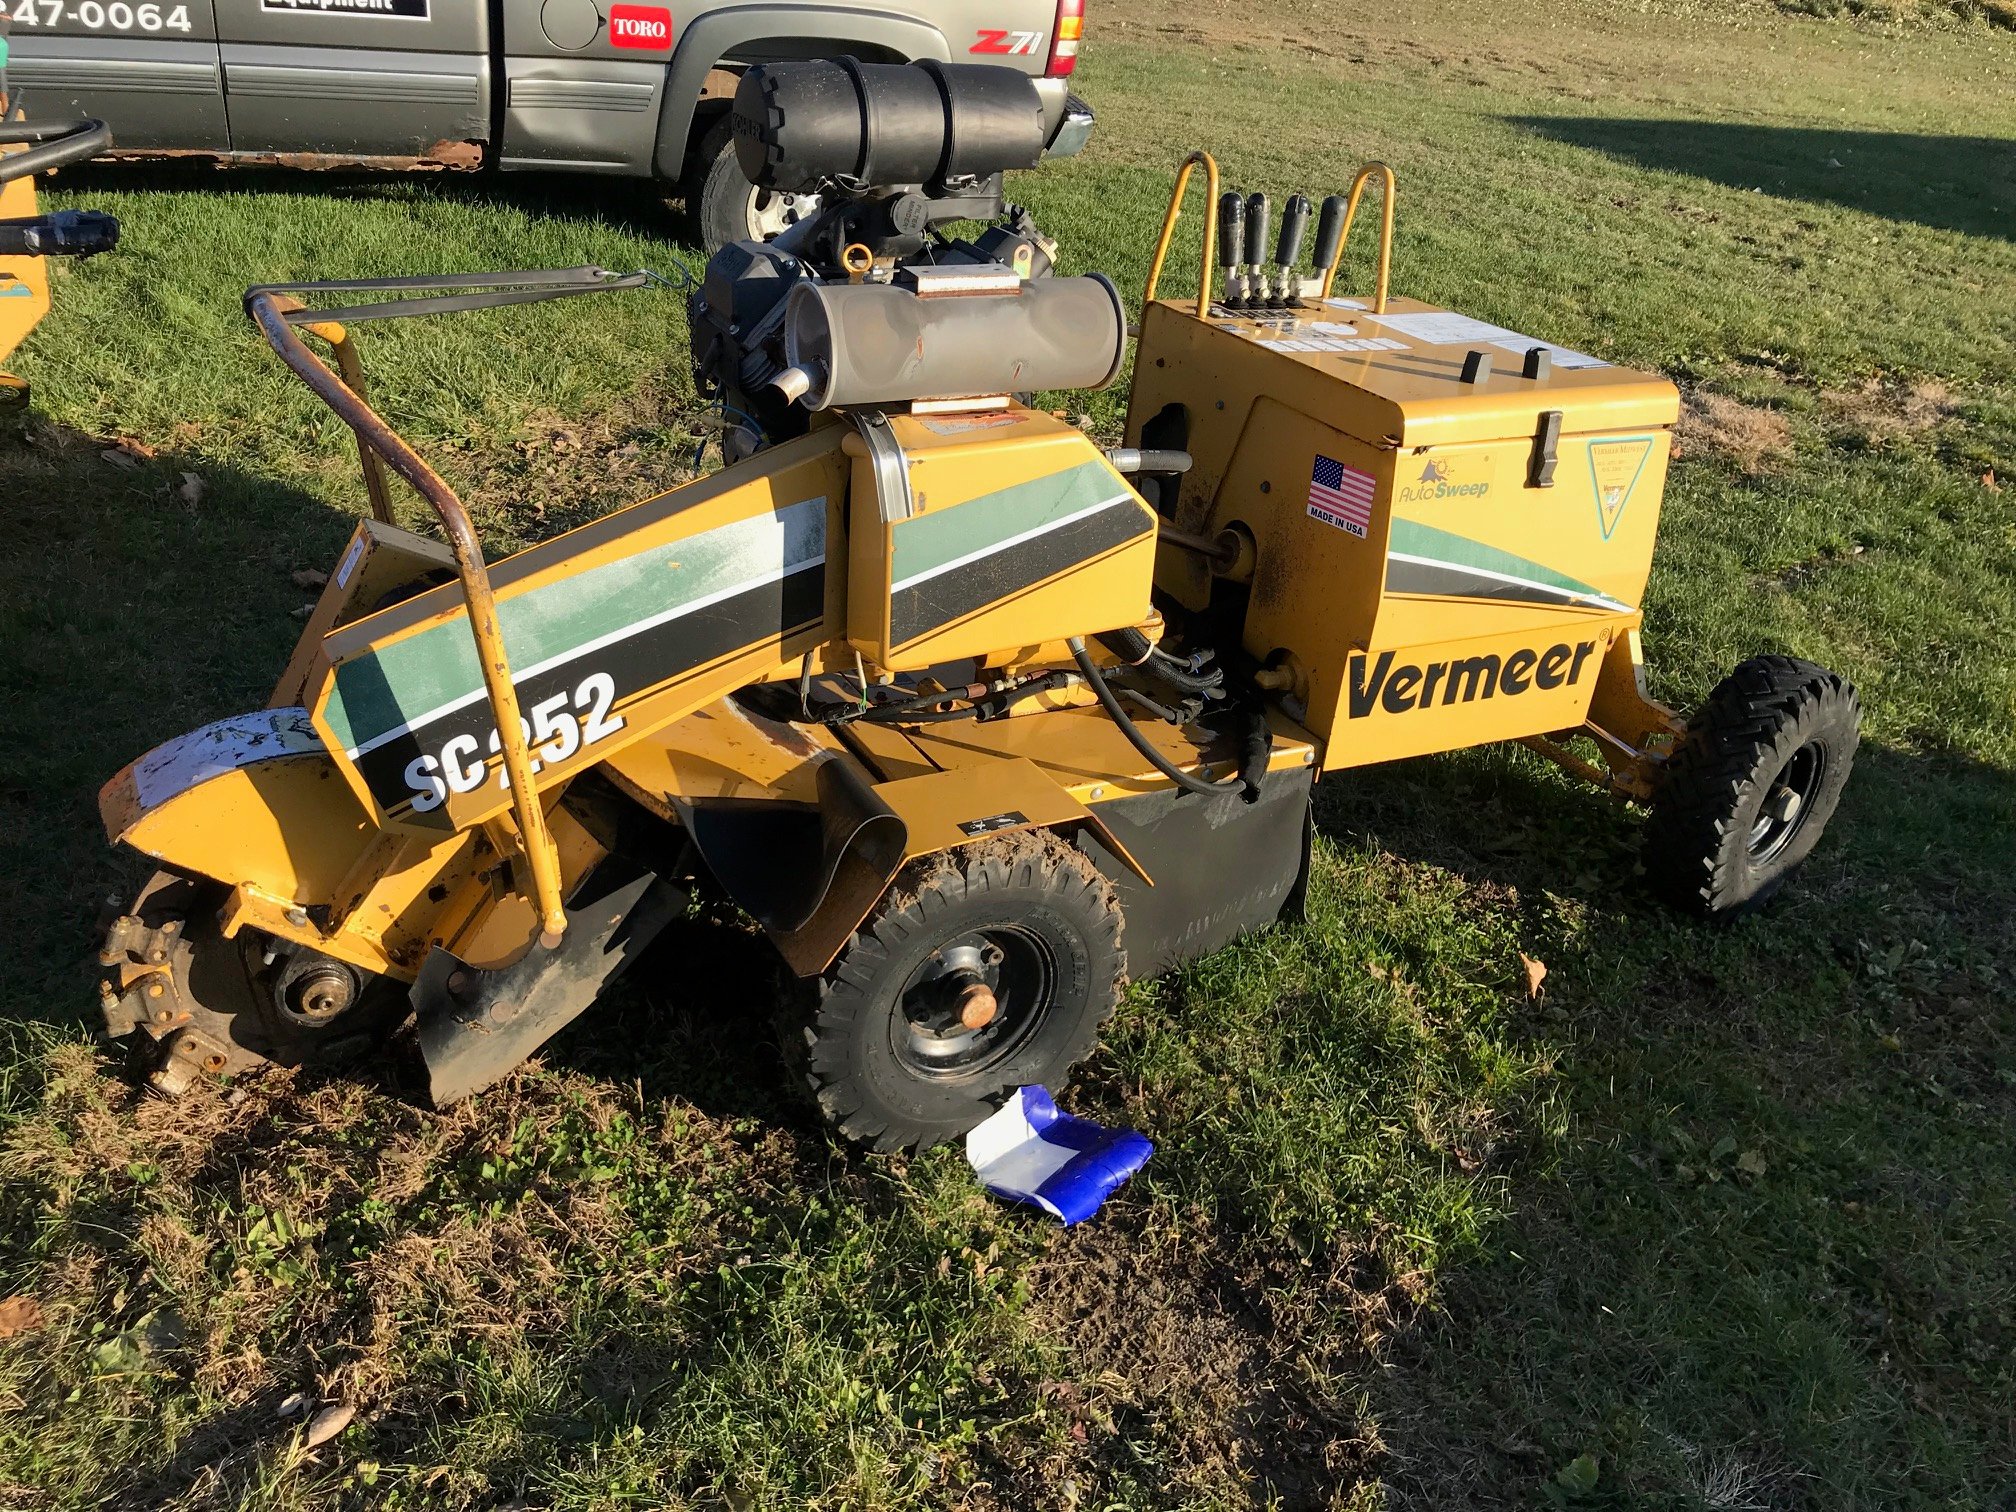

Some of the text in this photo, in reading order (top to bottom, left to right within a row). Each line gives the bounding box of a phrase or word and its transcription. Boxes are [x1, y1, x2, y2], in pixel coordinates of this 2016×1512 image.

[0, 0, 192, 32] 47-0064
[614, 18, 666, 38] TORO
[968, 29, 1044, 55] Z71
[1399, 481, 1489, 502] AutoSweep
[1311, 507, 1363, 536] MADE IN USA
[1349, 640, 1597, 719] Vermeer
[404, 733, 485, 813] SC
